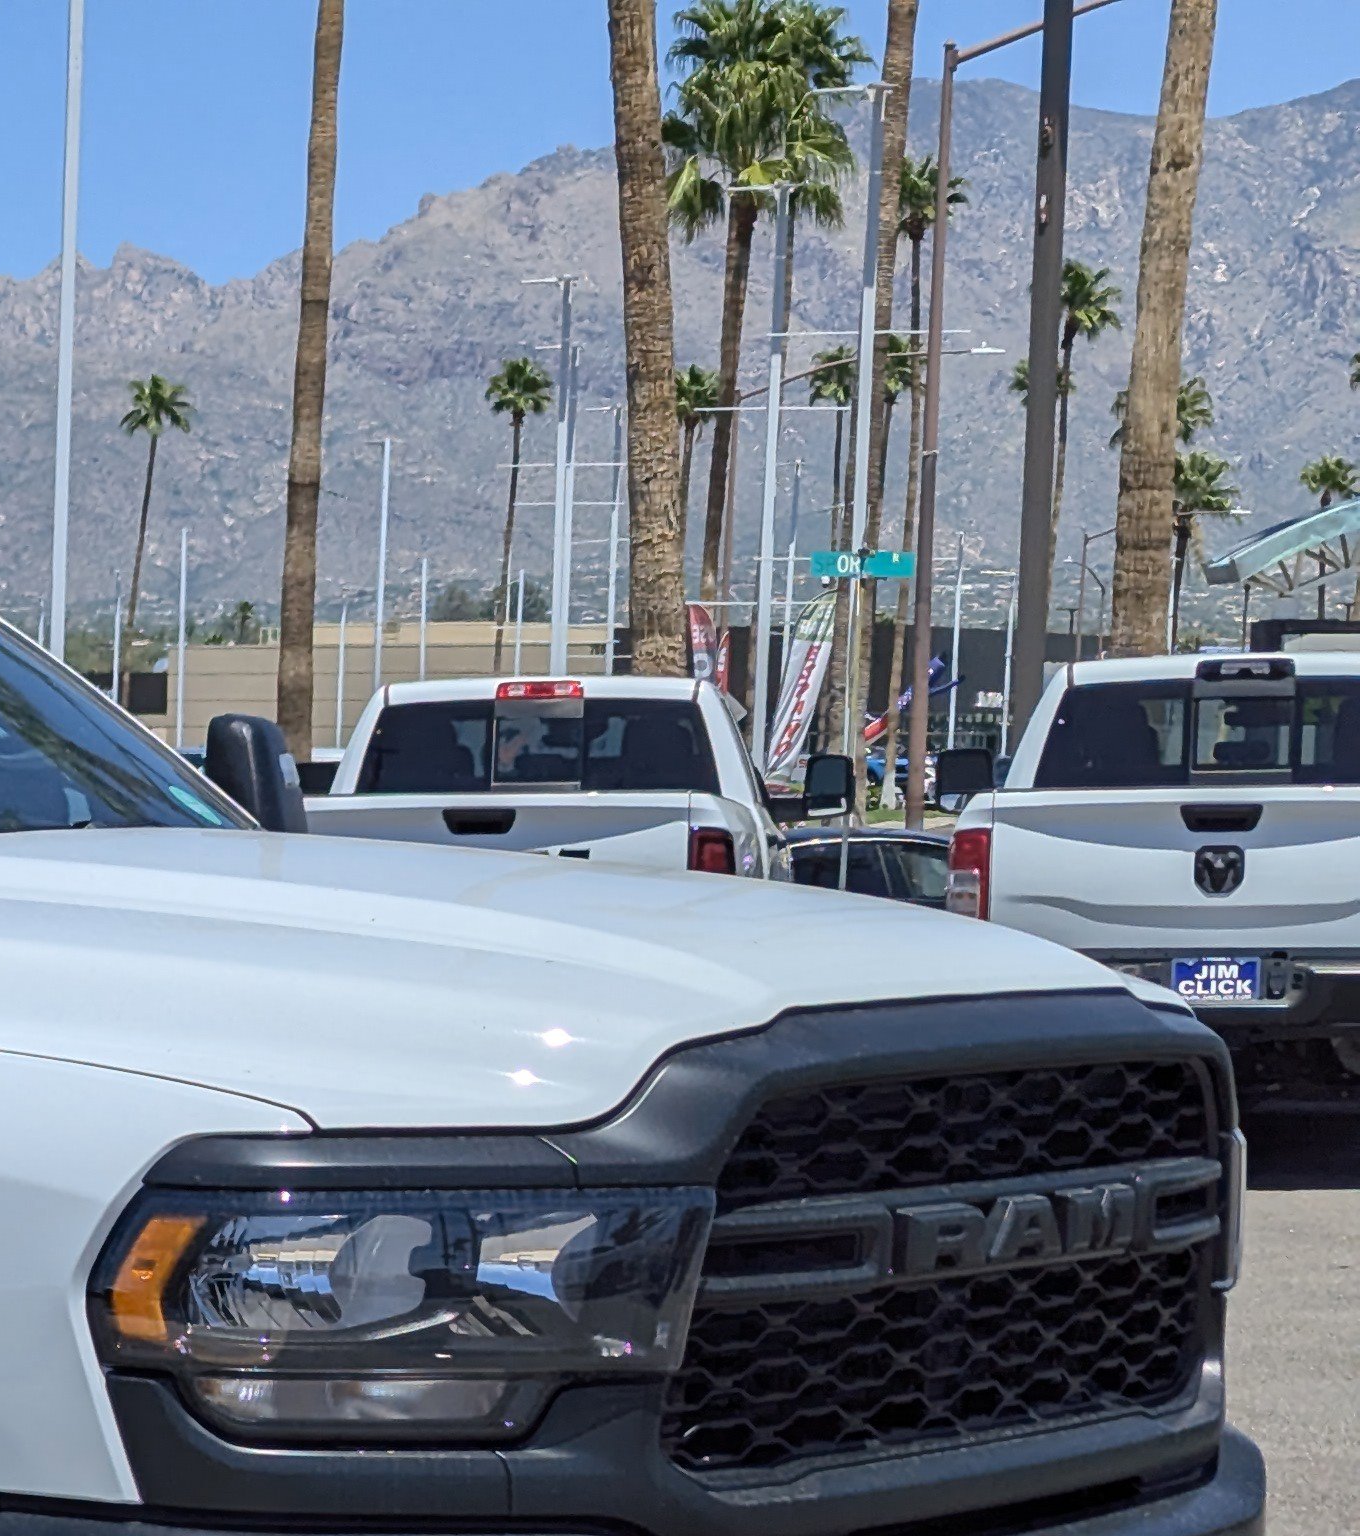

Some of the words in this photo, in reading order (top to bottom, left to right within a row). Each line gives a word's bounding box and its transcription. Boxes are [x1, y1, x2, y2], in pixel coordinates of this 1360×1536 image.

[1194, 964, 1239, 980] JIM
[1178, 978, 1253, 995] CLICK
[892, 1182, 1138, 1276] RAM
